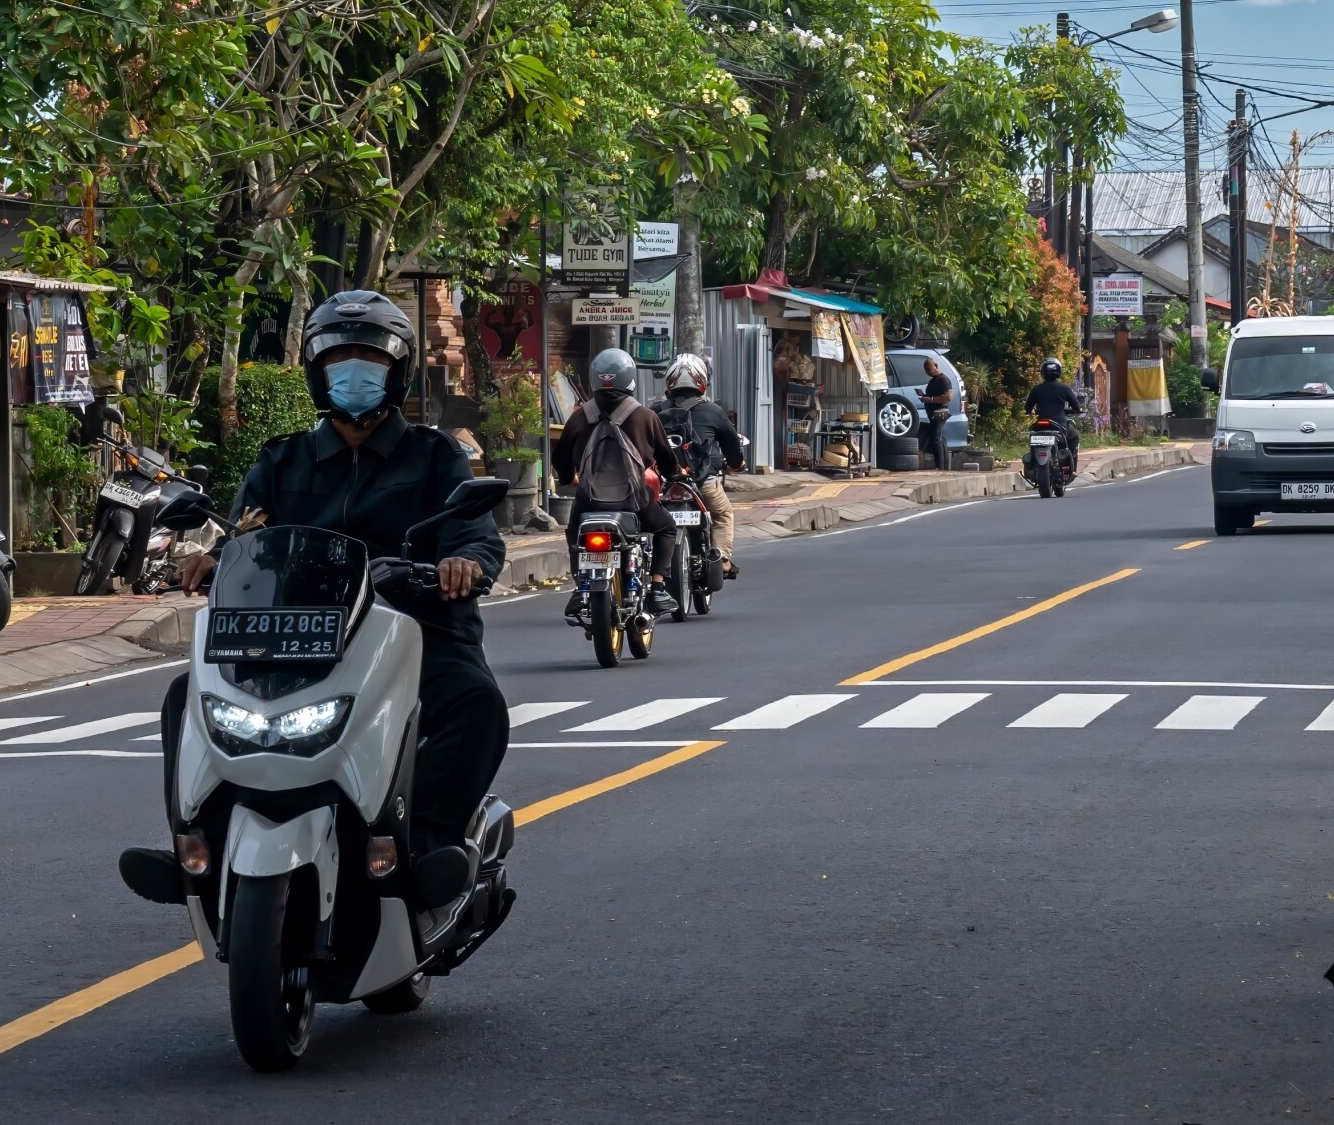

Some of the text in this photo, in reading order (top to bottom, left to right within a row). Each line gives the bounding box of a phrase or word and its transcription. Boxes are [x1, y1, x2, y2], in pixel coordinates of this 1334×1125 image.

[568, 249, 624, 263] TUDE GYM
[1282, 484, 1334, 494] DK 8259 DK
[216, 616, 240, 633] DK
